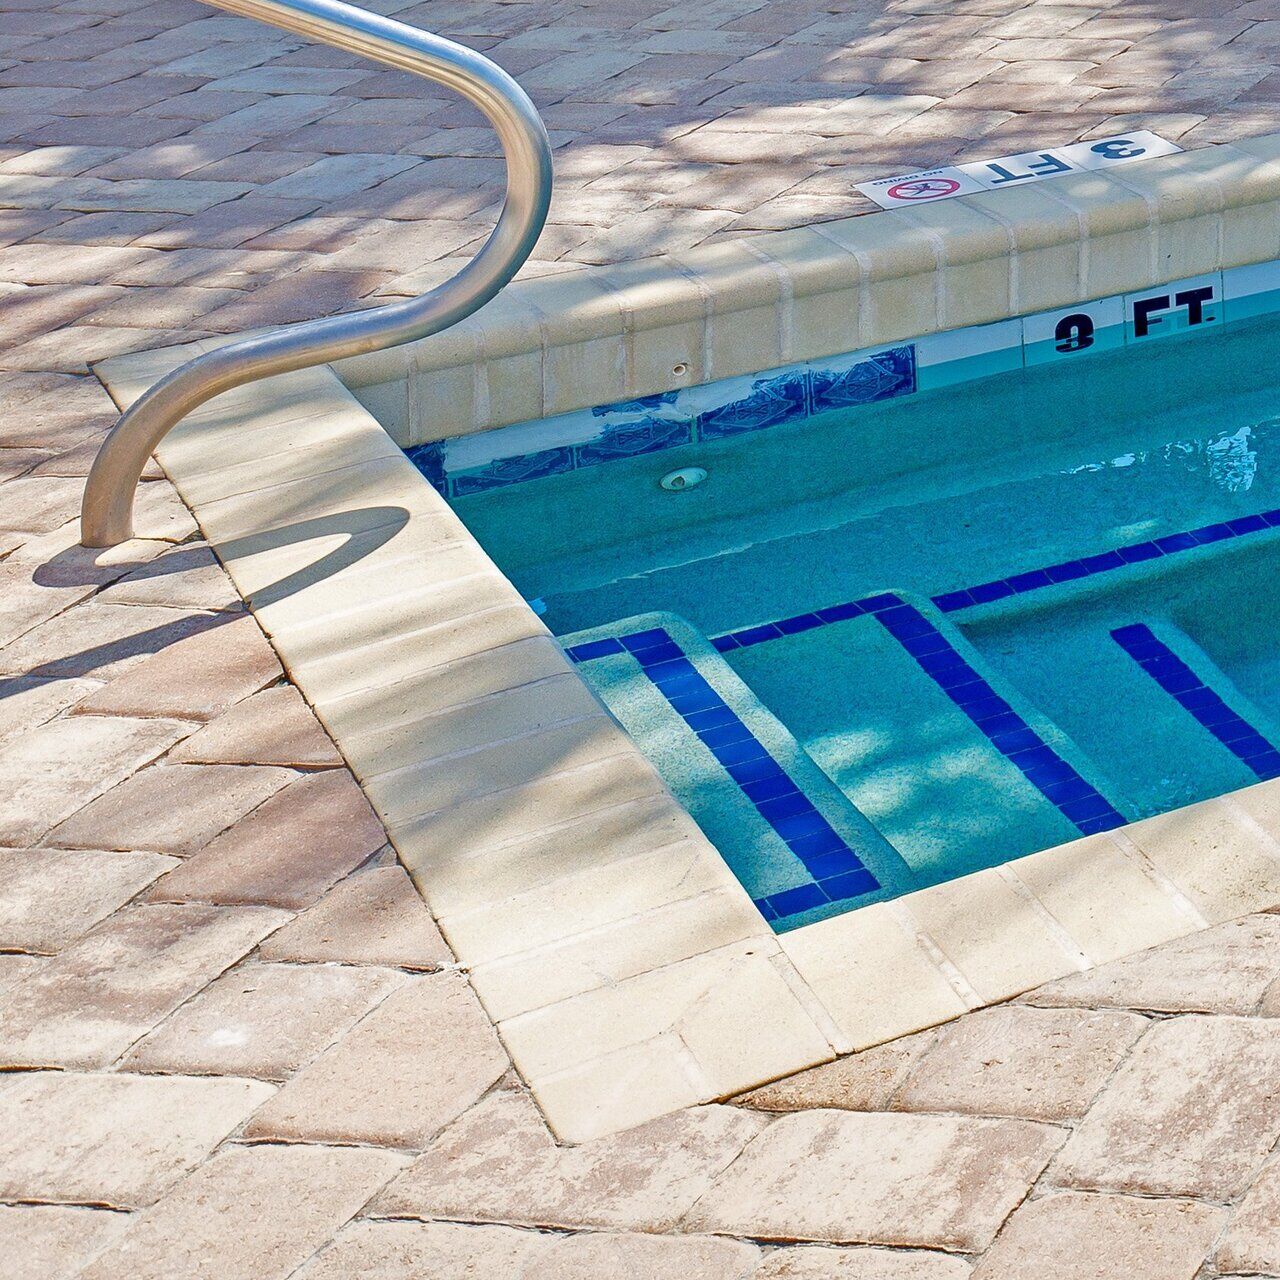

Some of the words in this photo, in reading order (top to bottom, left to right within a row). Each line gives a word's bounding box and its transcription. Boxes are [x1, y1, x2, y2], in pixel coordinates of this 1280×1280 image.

[1090, 139, 1146, 160] 3
[986, 154, 1074, 184] FT
[872, 175, 918, 186] DIVING
